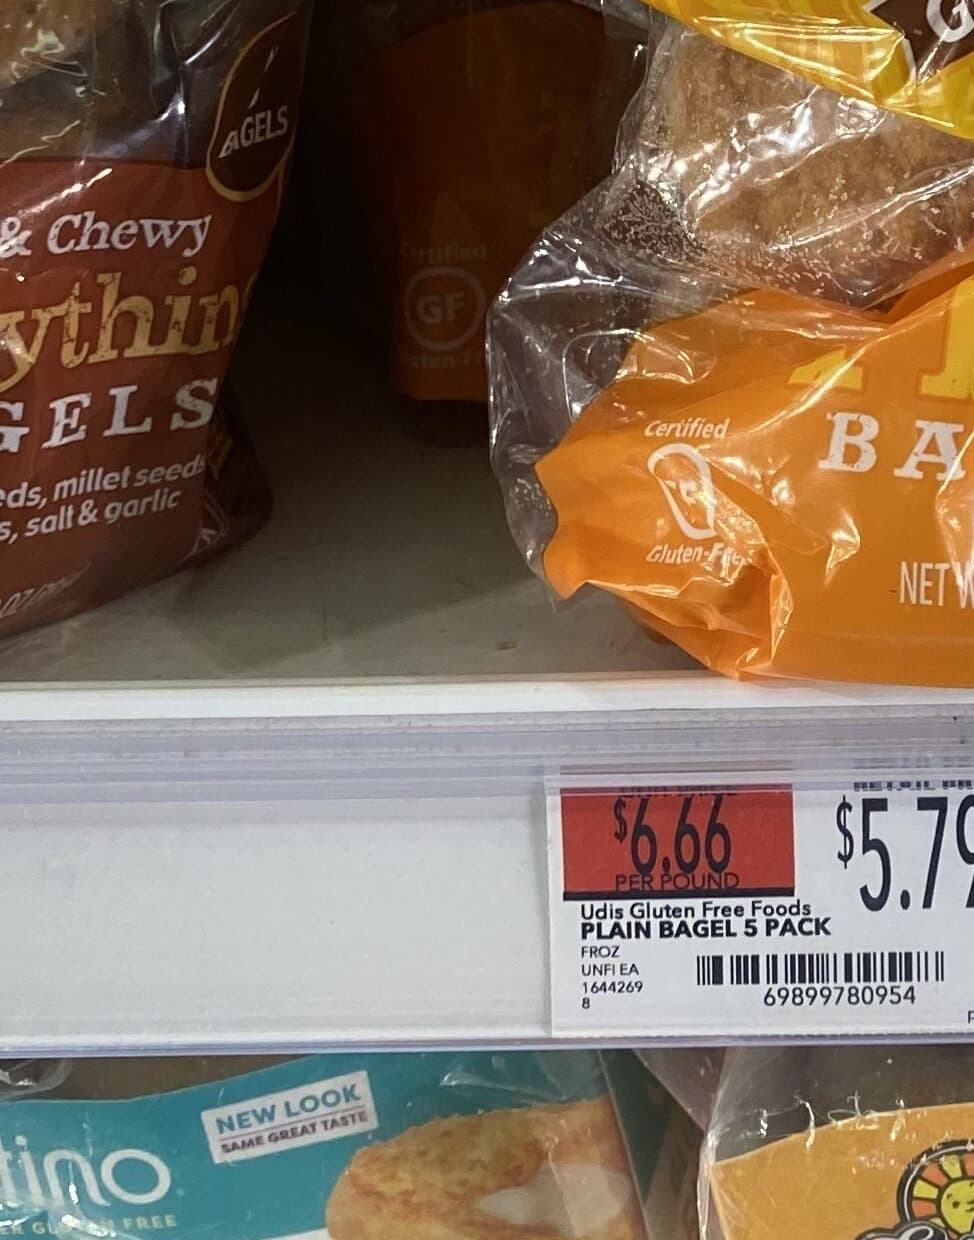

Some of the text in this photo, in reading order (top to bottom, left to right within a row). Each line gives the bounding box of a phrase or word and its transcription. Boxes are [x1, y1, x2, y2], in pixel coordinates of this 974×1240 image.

[0, 211, 212, 258] & Chewy
[644, 417, 731, 440] Certified
[53, 465, 132, 502] millet
[24, 505, 74, 537] salt
[78, 499, 99, 526] &
[104, 487, 182, 525] garlic
[646, 542, 748, 566] Gluten-F
[900, 560, 950, 608] NET
[613, 793, 732, 876] $6.66
[615, 872, 740, 892] PER POUND
[581, 899, 812, 920] Udis Gluten Free Foods
[581, 917, 831, 940] PLAIN BAGEL 5 PACK
[581, 945, 620, 958] FROZ
[581, 962, 639, 977] UNFI EA
[582, 980, 643, 994] 1644269
[763, 986, 916, 1006] 69899780954
[581, 996, 591, 1009] 8
[215, 1083, 361, 1135] NEW LOOK
[220, 1110, 368, 1155] SAME GREAT TASTE
[123, 1214, 177, 1230] FREE
